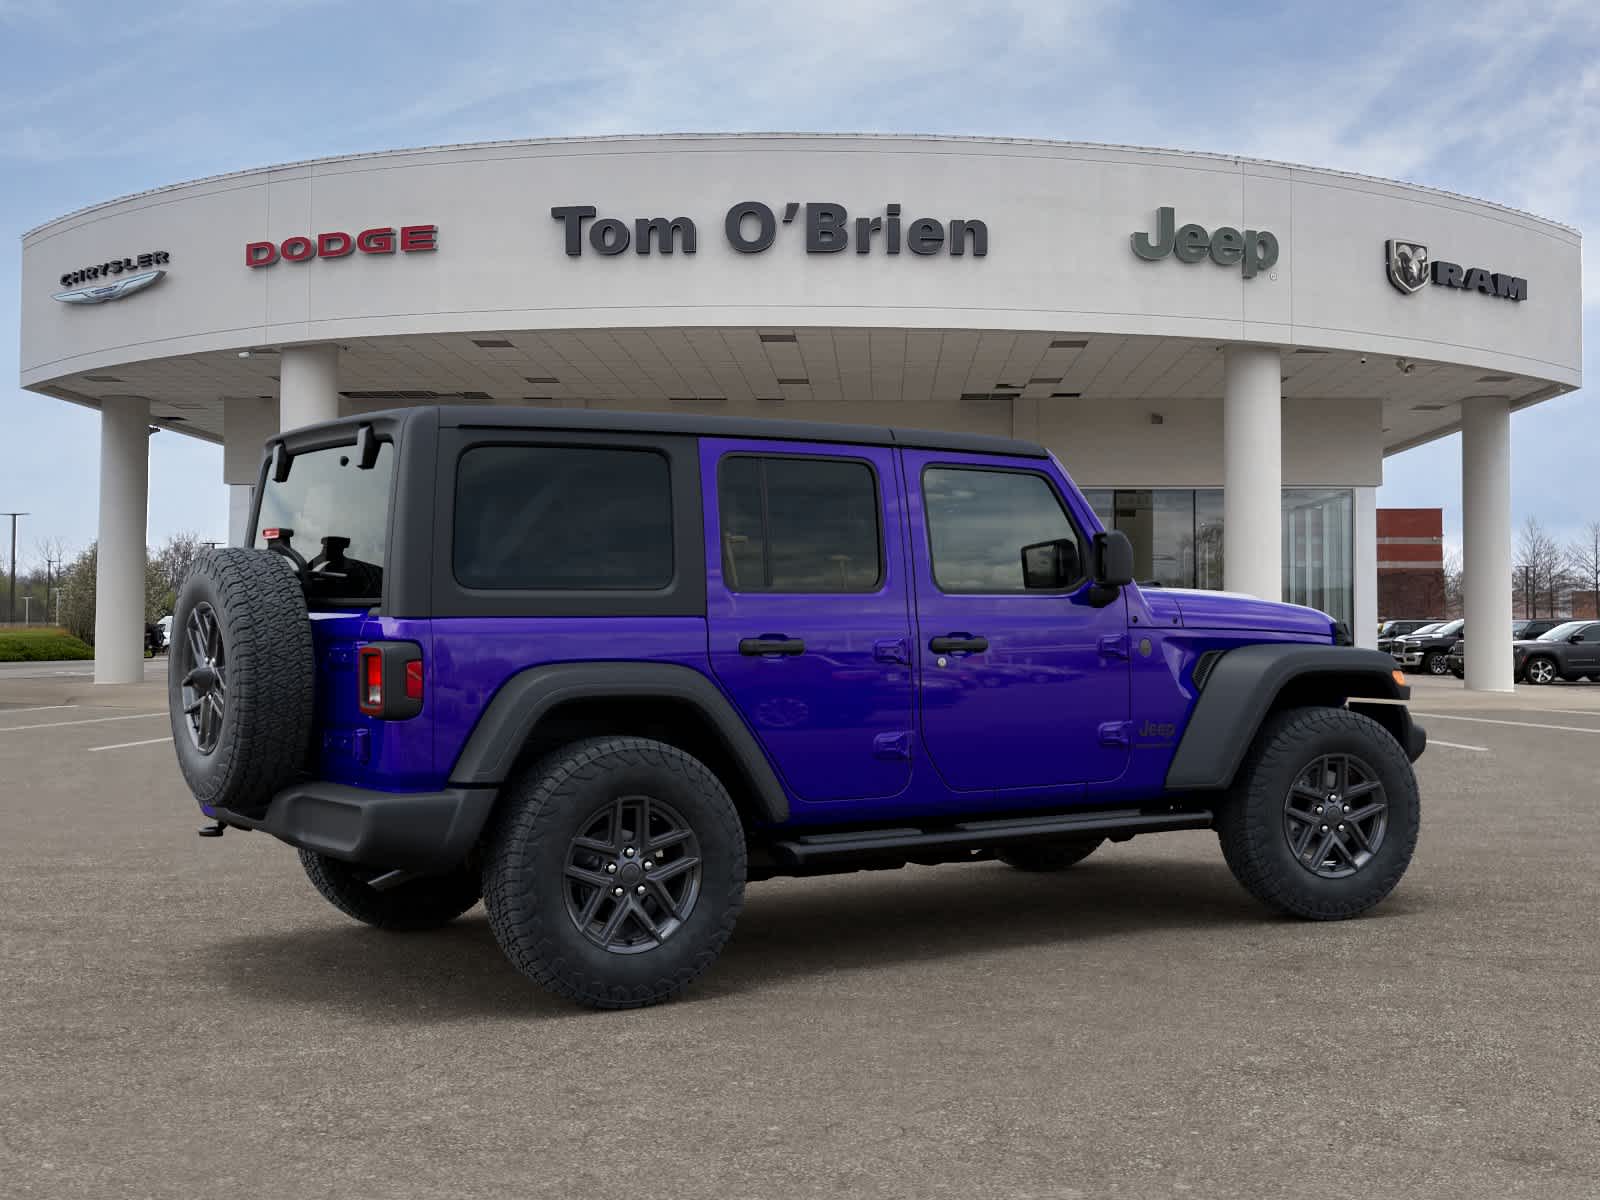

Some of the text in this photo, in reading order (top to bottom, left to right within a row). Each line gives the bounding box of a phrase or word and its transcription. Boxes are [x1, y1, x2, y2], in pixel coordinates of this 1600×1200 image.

[245, 224, 439, 268] DODGE
[551, 201, 988, 257] Tom O'Brien
[1130, 206, 1279, 279] Jeep
[60, 250, 169, 287] CHRYSLER
[1431, 260, 1527, 300] RAM
[1138, 719, 1175, 739] Jeep
